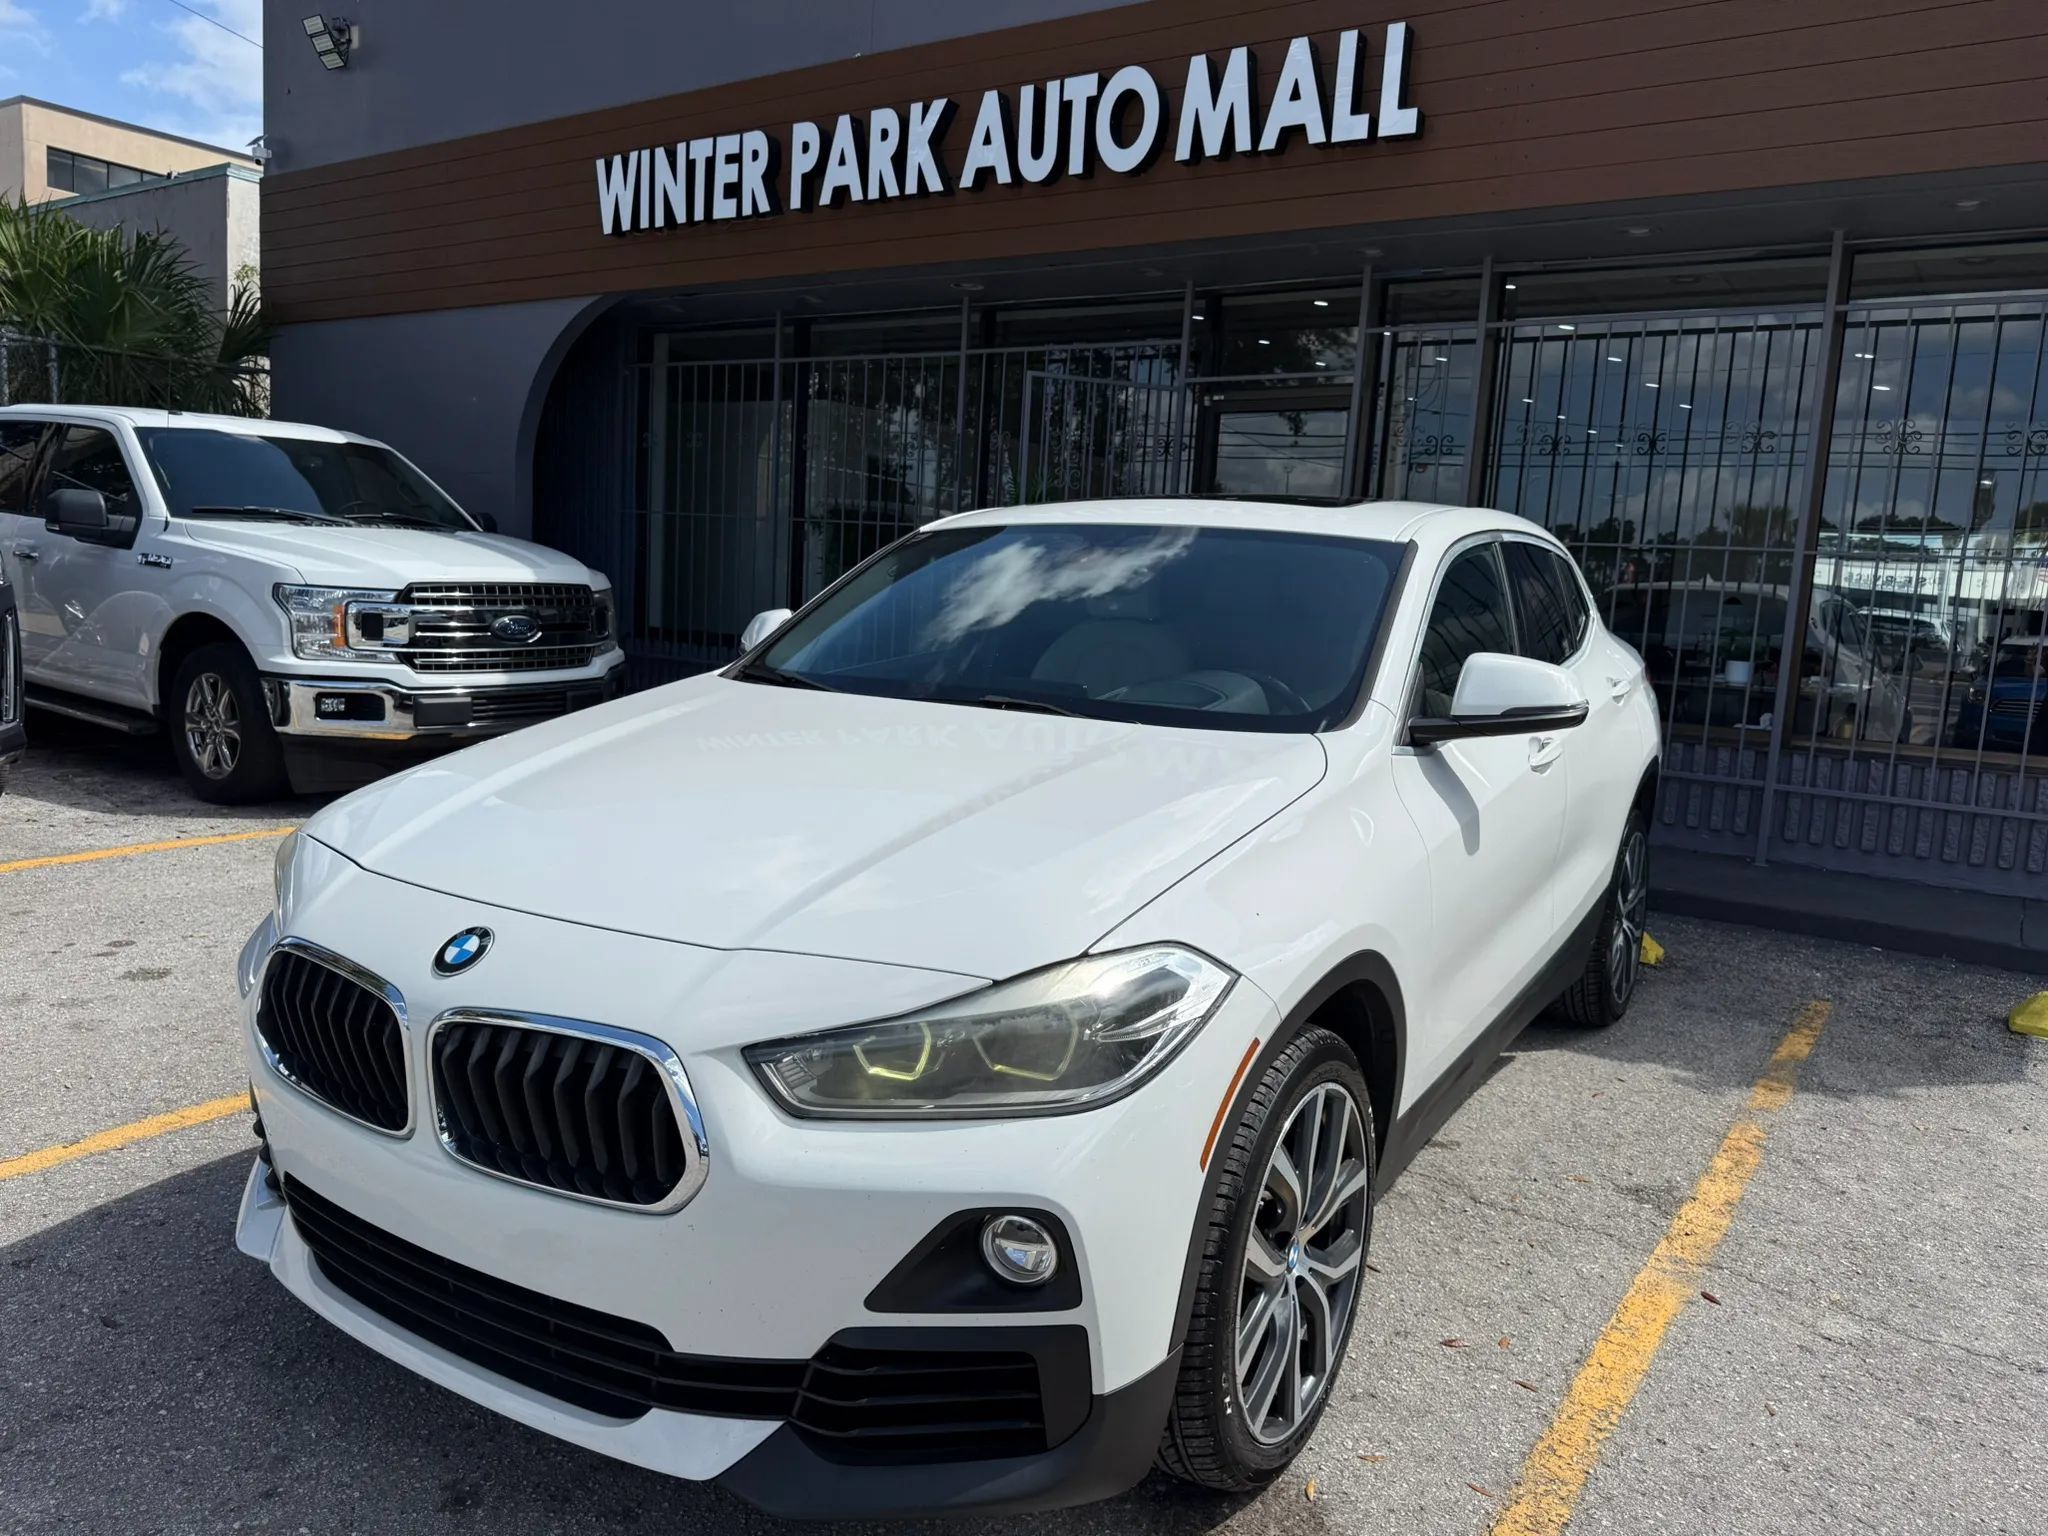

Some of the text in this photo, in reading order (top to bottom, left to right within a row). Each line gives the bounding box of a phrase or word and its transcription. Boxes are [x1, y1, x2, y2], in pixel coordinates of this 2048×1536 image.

[596, 22, 1418, 235] WINTER PARK AUTO MALL
